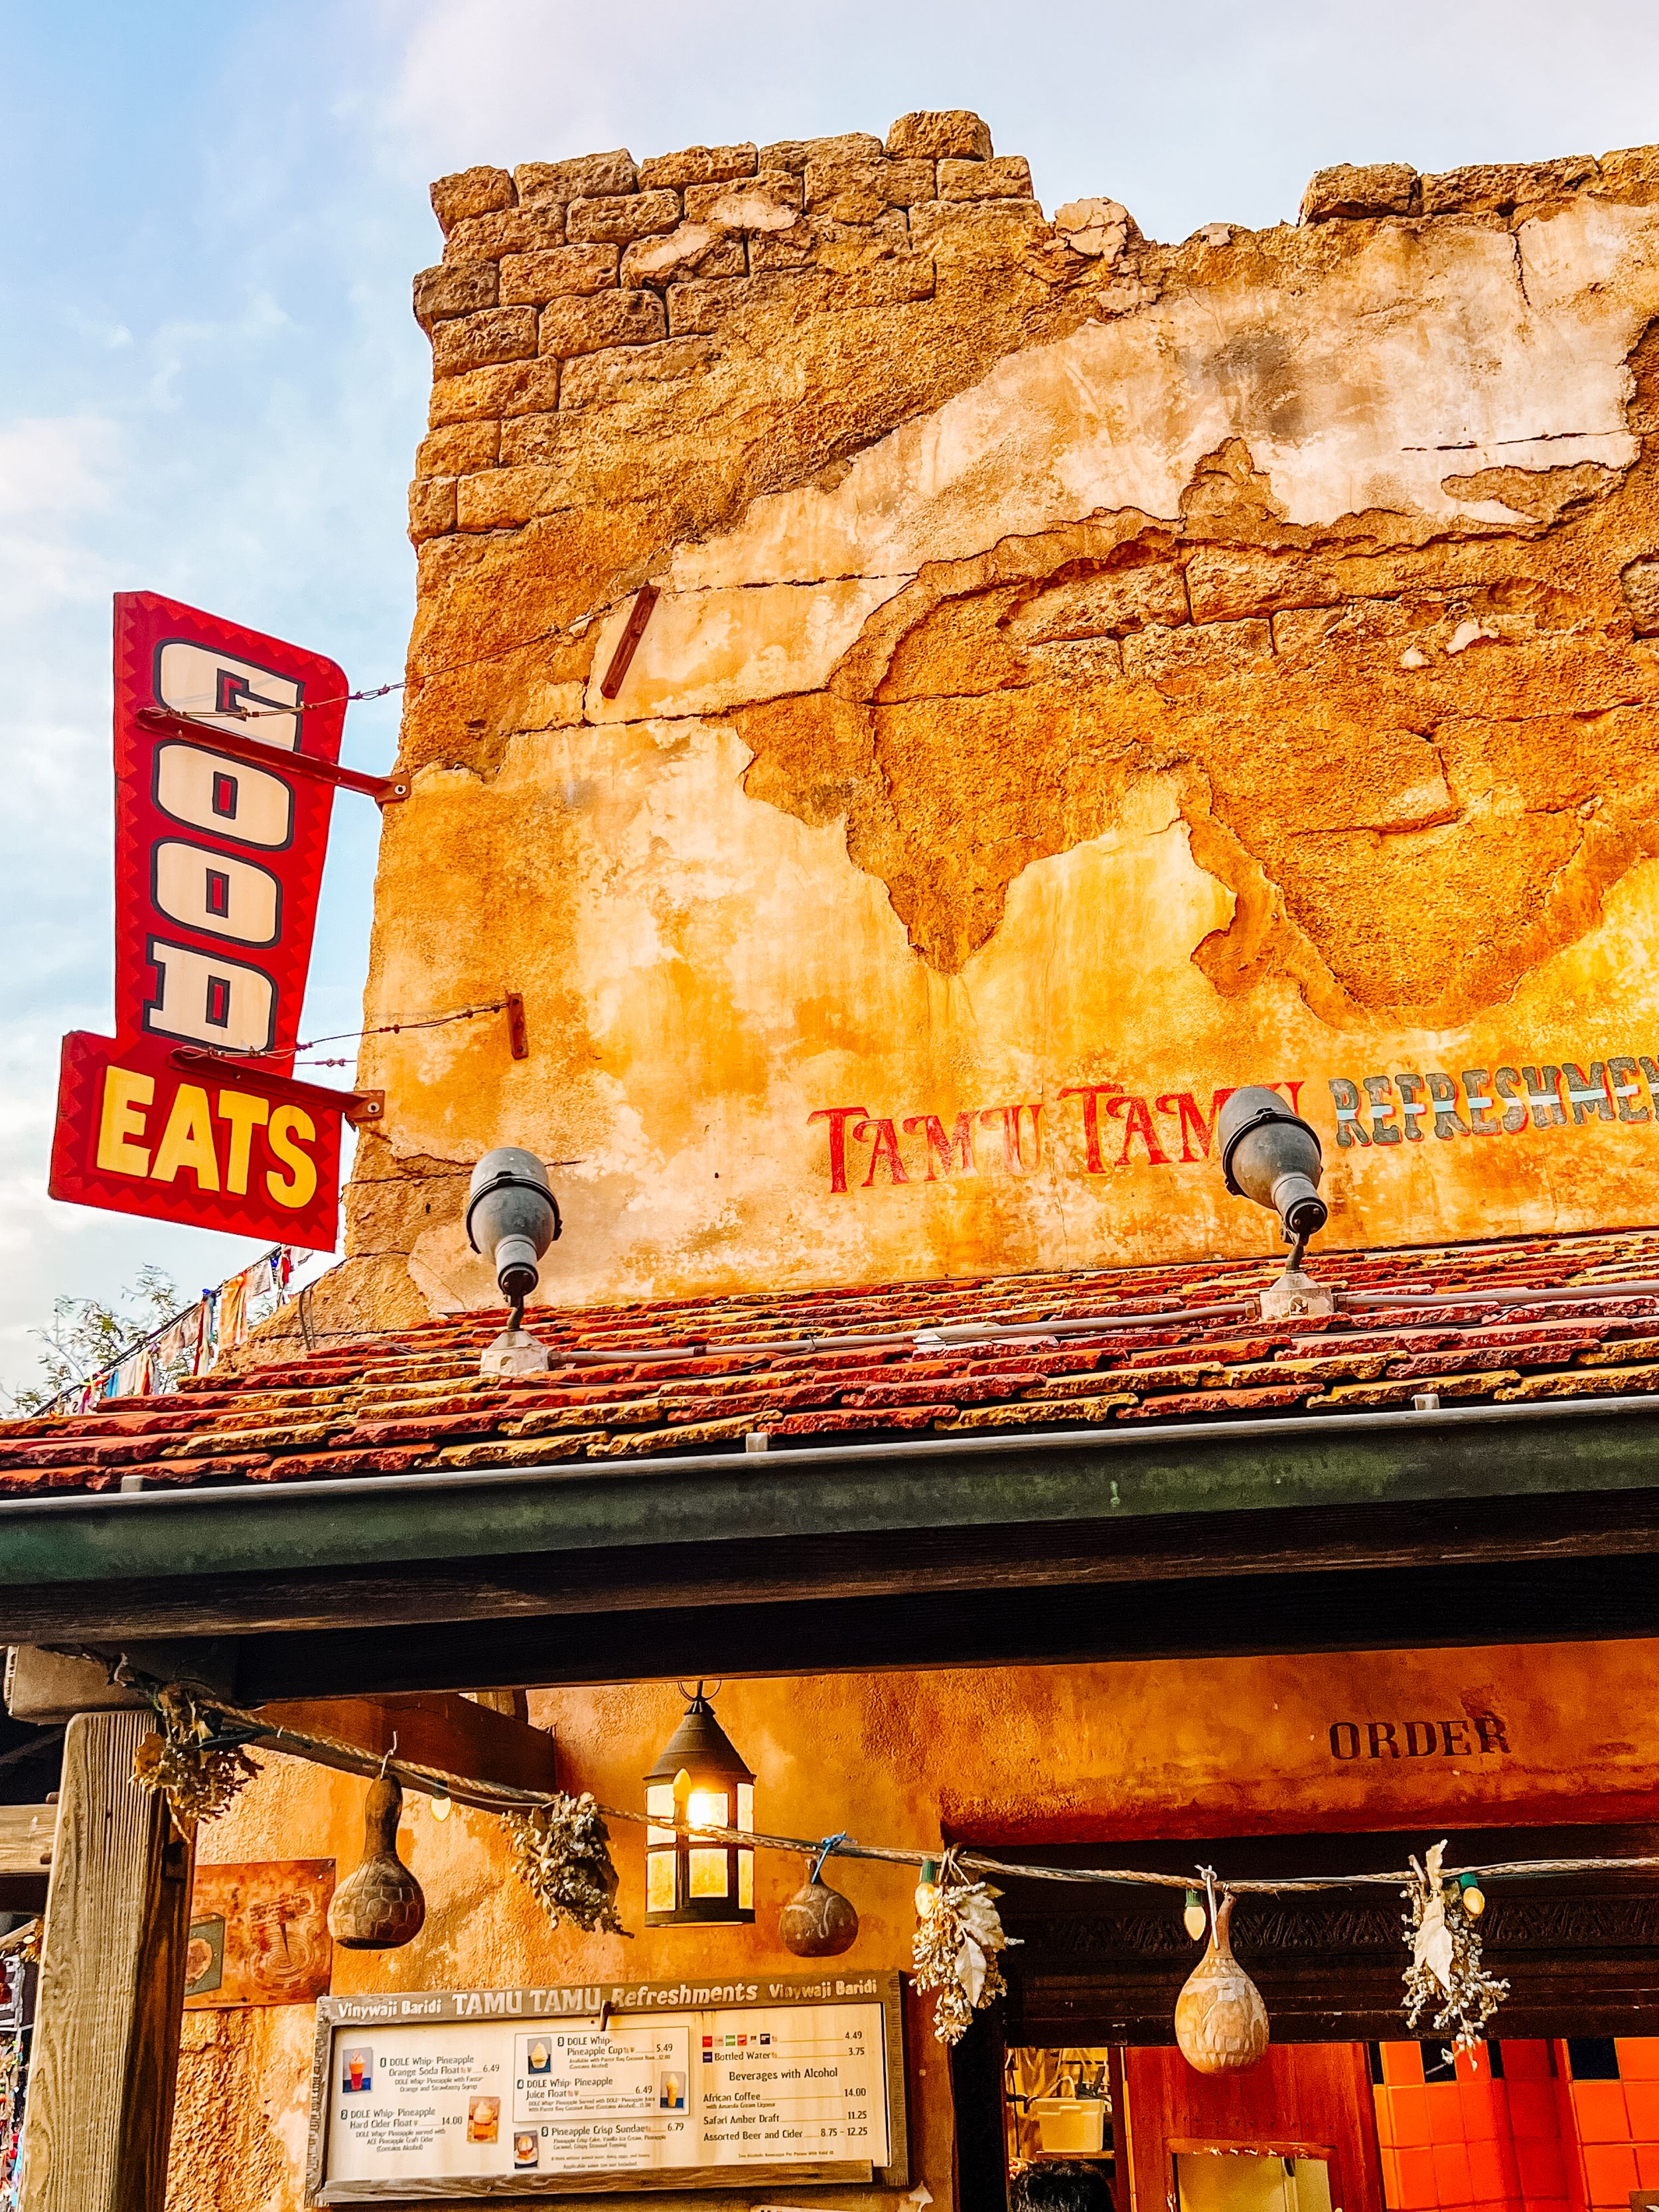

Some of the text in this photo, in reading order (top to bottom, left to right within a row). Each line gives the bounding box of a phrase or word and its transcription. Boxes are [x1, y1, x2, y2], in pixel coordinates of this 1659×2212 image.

[141, 638, 304, 1053] GOOD
[96, 1065, 317, 1209] EATS
[807, 1104, 1045, 1193] TAMU
[1329, 1710, 1512, 1759] ORDER
[338, 1979, 877, 2019] Vinywaji Baridi TAMU TAMU Refreshments Vinywaji Baridi
[567, 2037, 587, 2046] DOLE
[845, 2031, 862, 2040] 4.49
[567, 2043, 673, 2056] Pineapple Cup 5.49
[714, 2047, 865, 2061] Bottled Water 3.75
[390, 2057, 409, 2067] DOLE
[436, 2055, 474, 2066] Pineapple
[389, 2064, 500, 2077] Orange Soda Float 6.49
[729, 2067, 838, 2083] Beverages with Alcohol
[526, 2079, 547, 2089] DOLE
[575, 2077, 613, 2087] Pineapple
[526, 2085, 652, 2101] Juice Float 6.49
[703, 2088, 866, 2102] African Coffee 14.00
[350, 2109, 370, 2118] DOLE
[397, 2107, 435, 2118] Pineapple
[703, 2110, 867, 2125] Safari Amber Draft 11.25
[350, 2116, 463, 2129] Hard Cider Float 14.00
[551, 2126, 590, 2136] Pineapple
[593, 2125, 613, 2136] Crisp
[616, 2124, 645, 2134] Sundae
[668, 2122, 684, 2131] 6.79
[703, 2131, 739, 2141] Assorted
[743, 2130, 761, 2140] Beer
[764, 2130, 779, 2138] and
[782, 2129, 803, 2138] Cider
[820, 2128, 837, 2137] 8.75
[847, 2127, 868, 2136] 12.25
